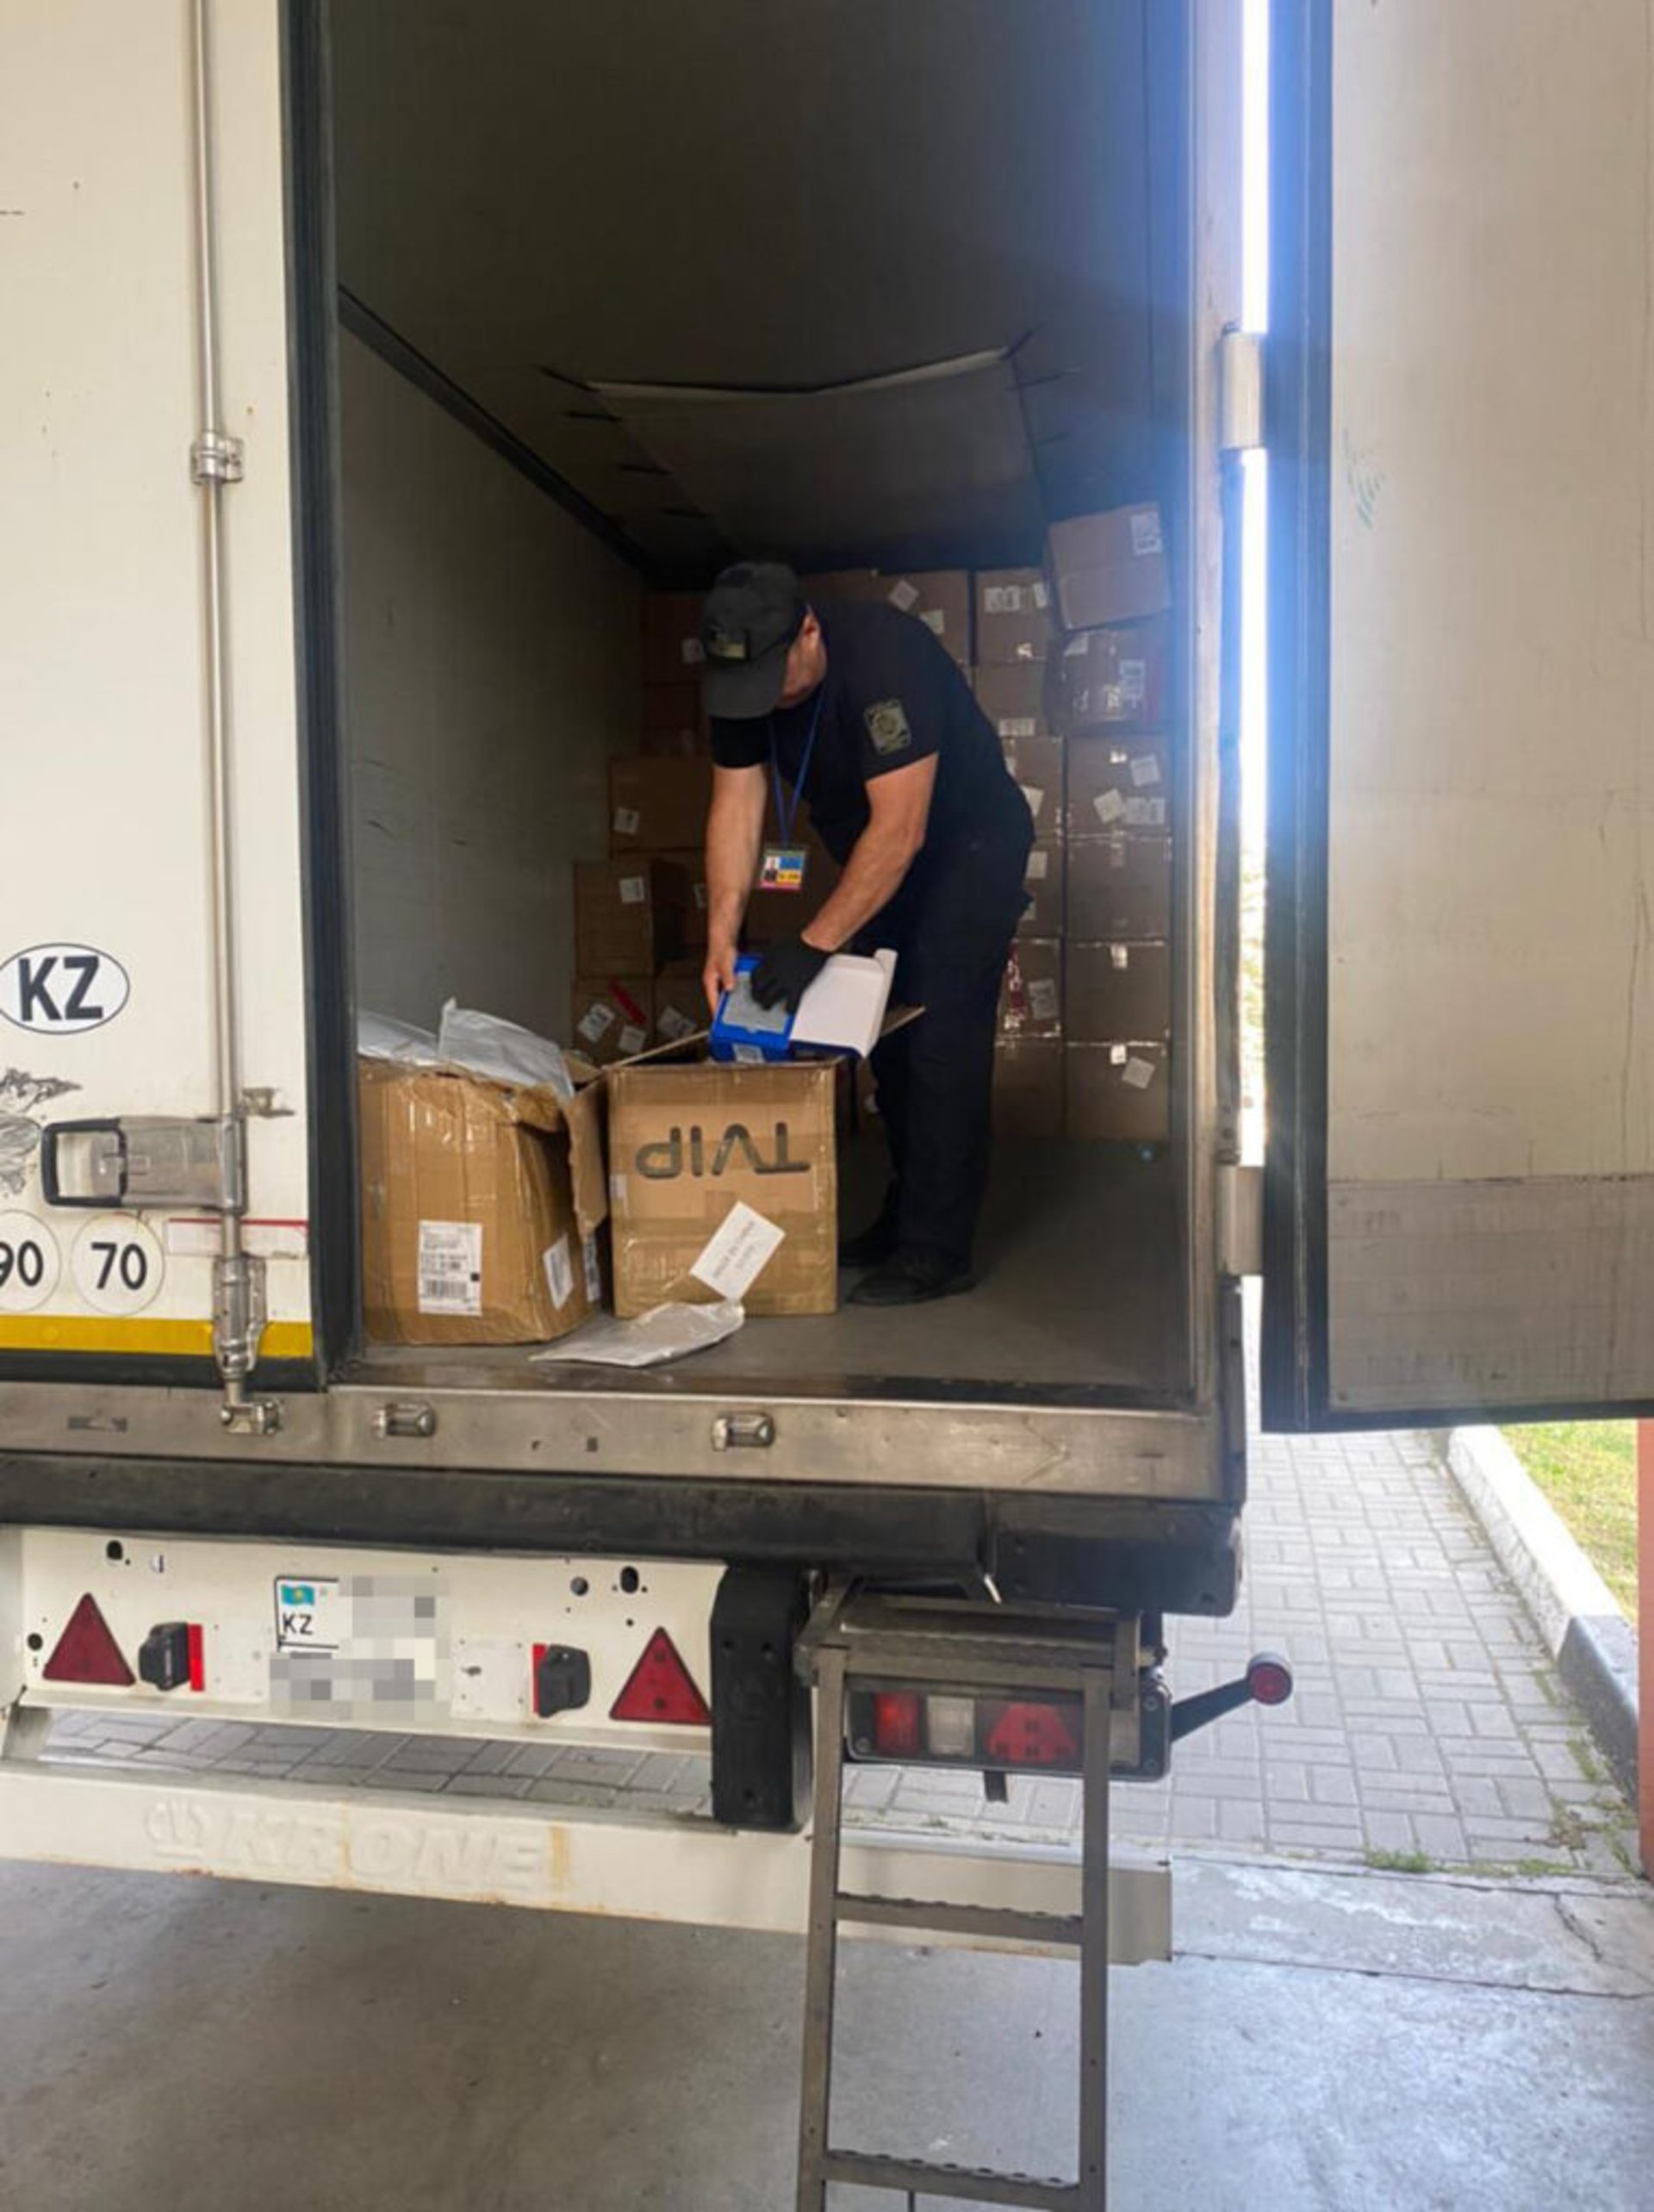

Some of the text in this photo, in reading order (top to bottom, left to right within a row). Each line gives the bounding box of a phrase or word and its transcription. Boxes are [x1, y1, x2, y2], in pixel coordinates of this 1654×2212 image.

[18, 956, 103, 1022] KZ
[635, 1121, 811, 1180] TVIP
[90, 1242, 147, 1290] 70
[282, 1612, 314, 1636] KZ
